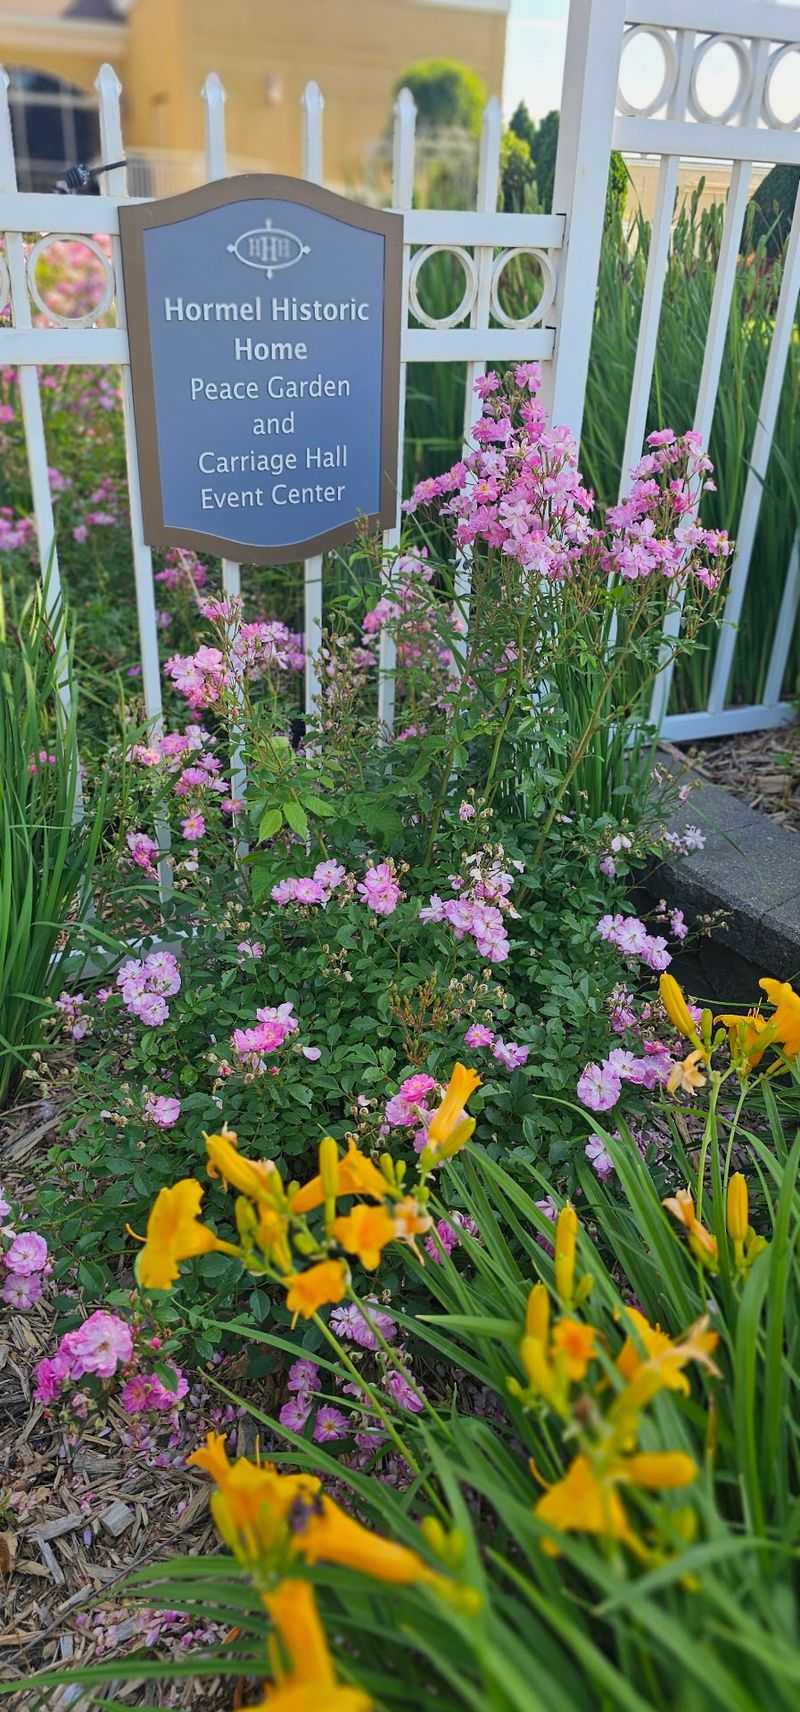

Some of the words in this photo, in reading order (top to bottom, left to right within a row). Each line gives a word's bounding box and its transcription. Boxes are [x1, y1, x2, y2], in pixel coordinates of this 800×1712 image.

[164, 296, 262, 321] Hormel
[272, 296, 370, 321] Historic
[234, 337, 308, 361] Home
[190, 377, 260, 401] Peace
[267, 373, 351, 399] Garden
[252, 411, 295, 435] and
[198, 451, 297, 476] Carriage
[306, 445, 348, 469] Hall
[201, 487, 264, 510] Event
[271, 484, 346, 507] Center
